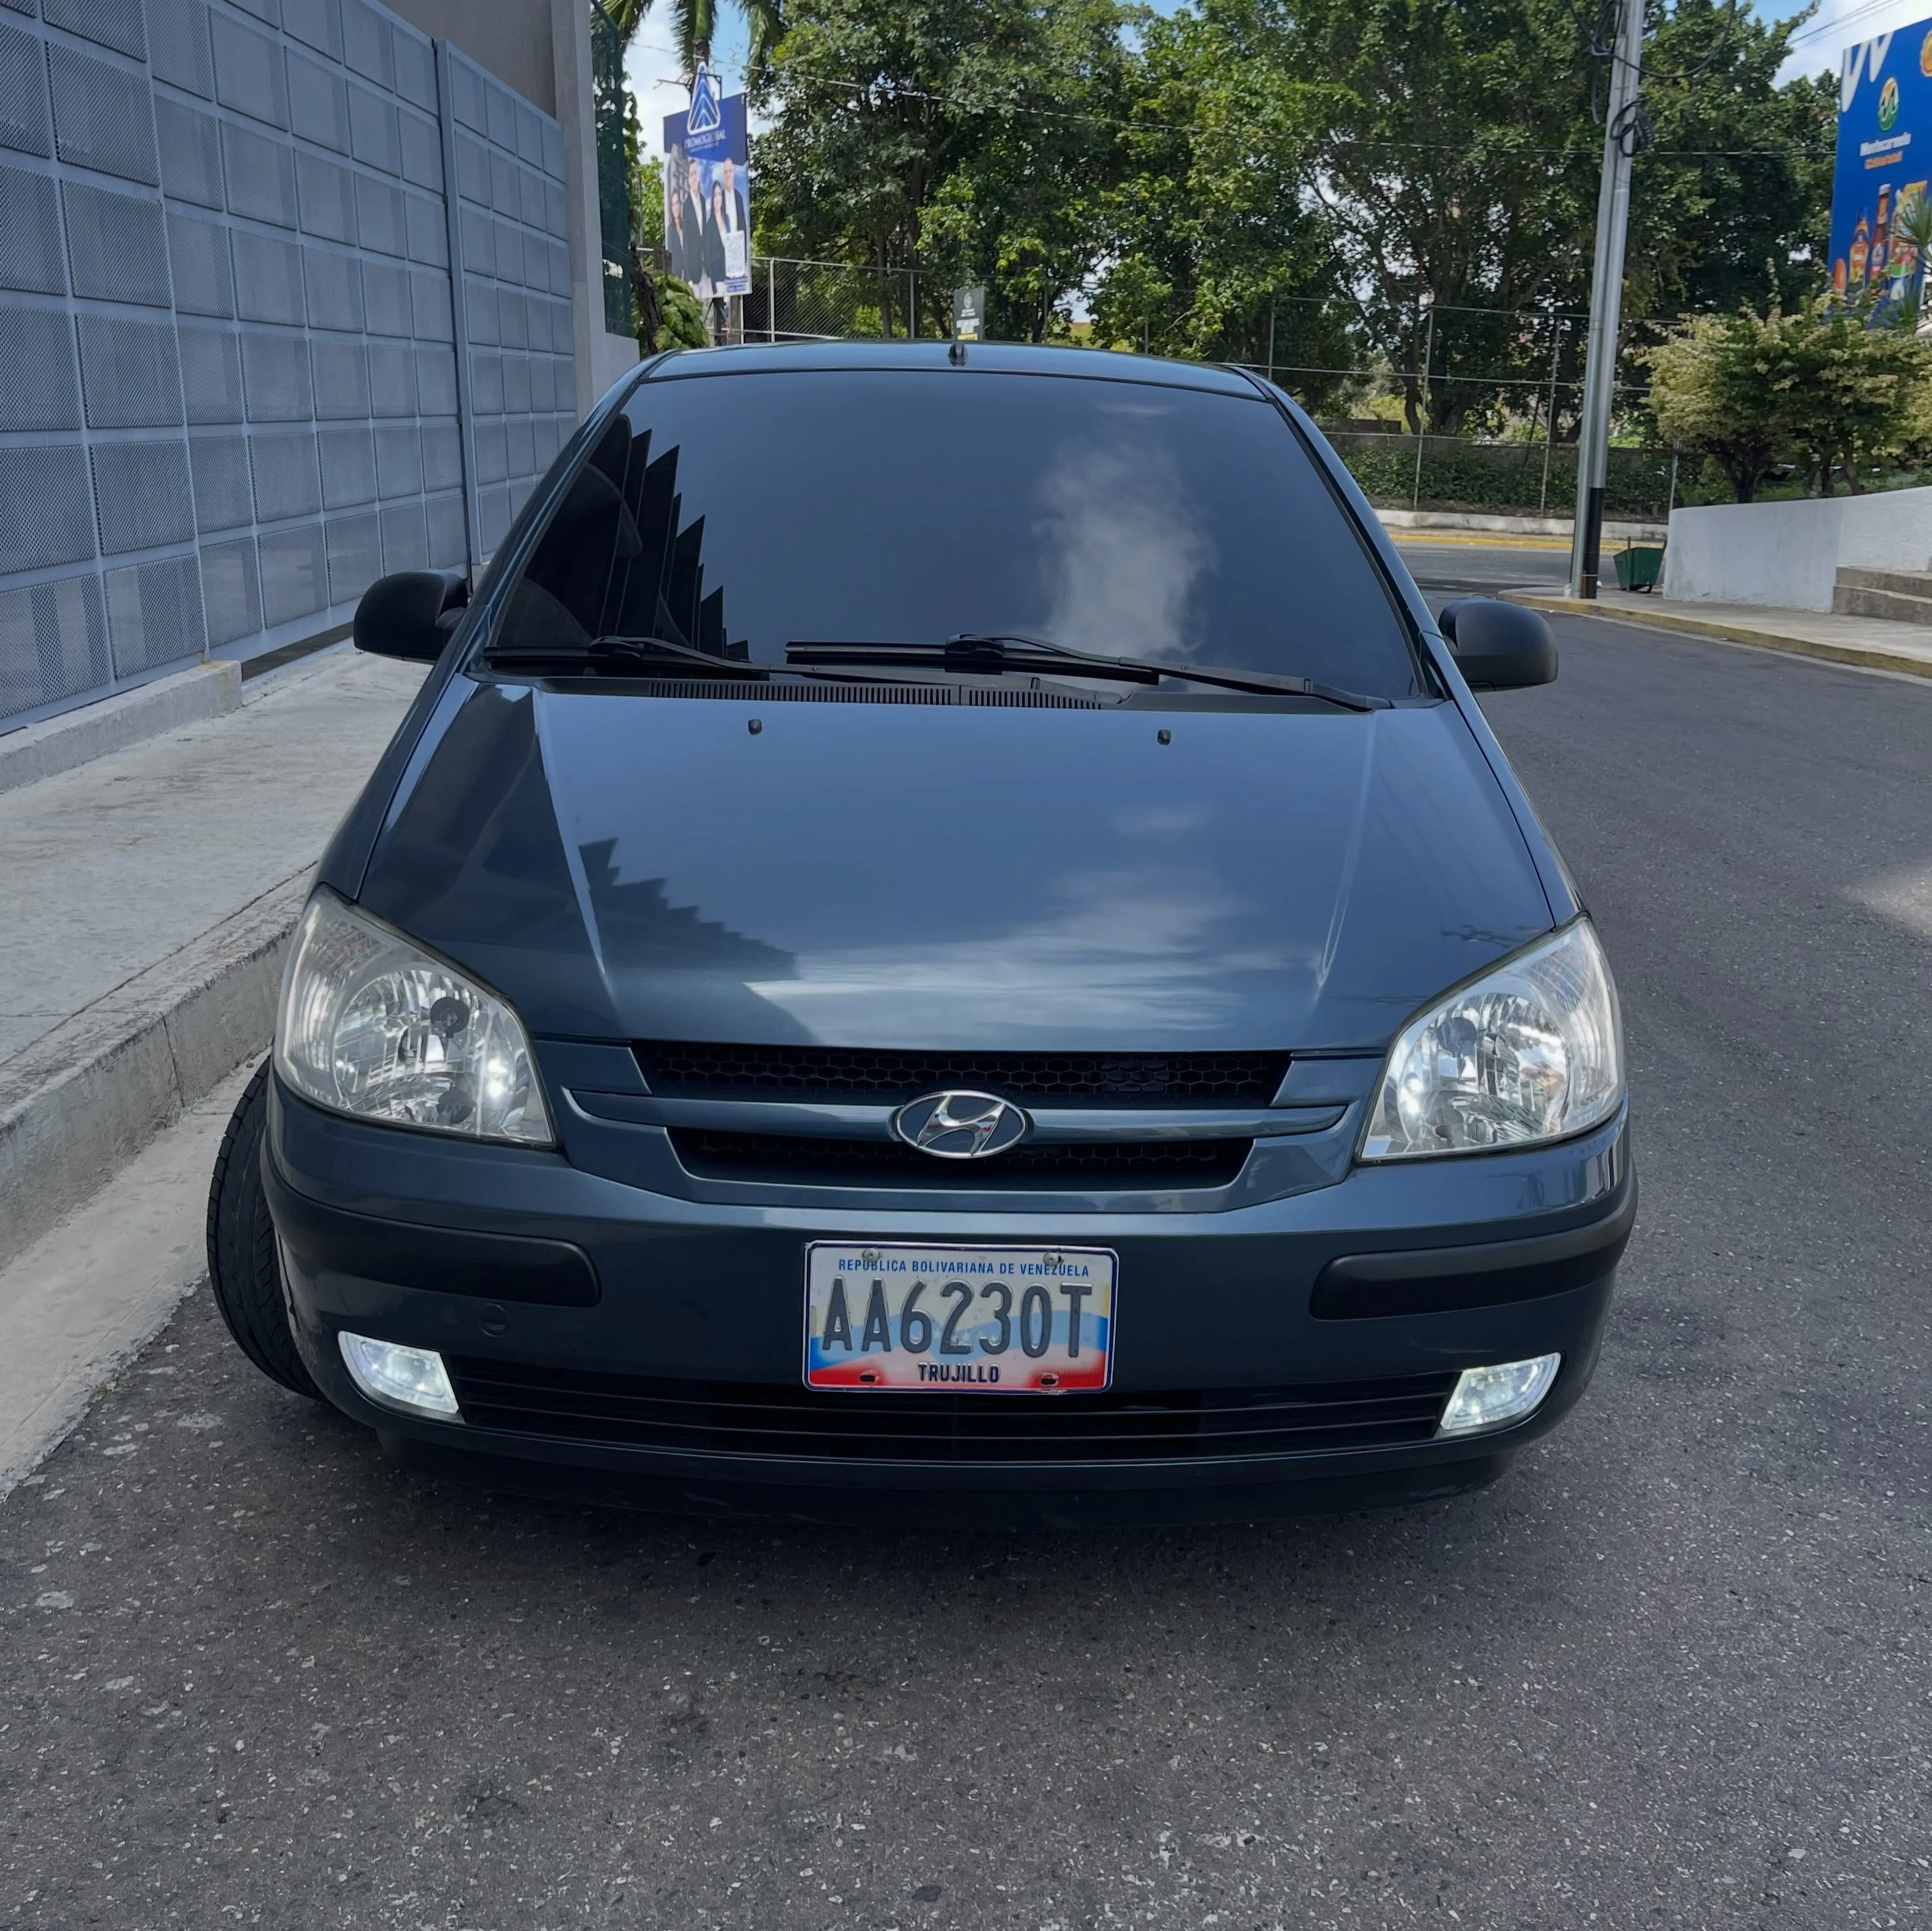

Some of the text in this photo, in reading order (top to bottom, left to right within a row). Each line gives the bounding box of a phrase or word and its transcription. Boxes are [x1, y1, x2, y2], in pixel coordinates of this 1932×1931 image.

[912, 1260, 994, 1273] BOLIVARIANA
[1000, 1263, 1015, 1274] DE
[1020, 1263, 1089, 1277] VENEZUELA
[917, 1362, 1000, 1383] TRUJILLO
